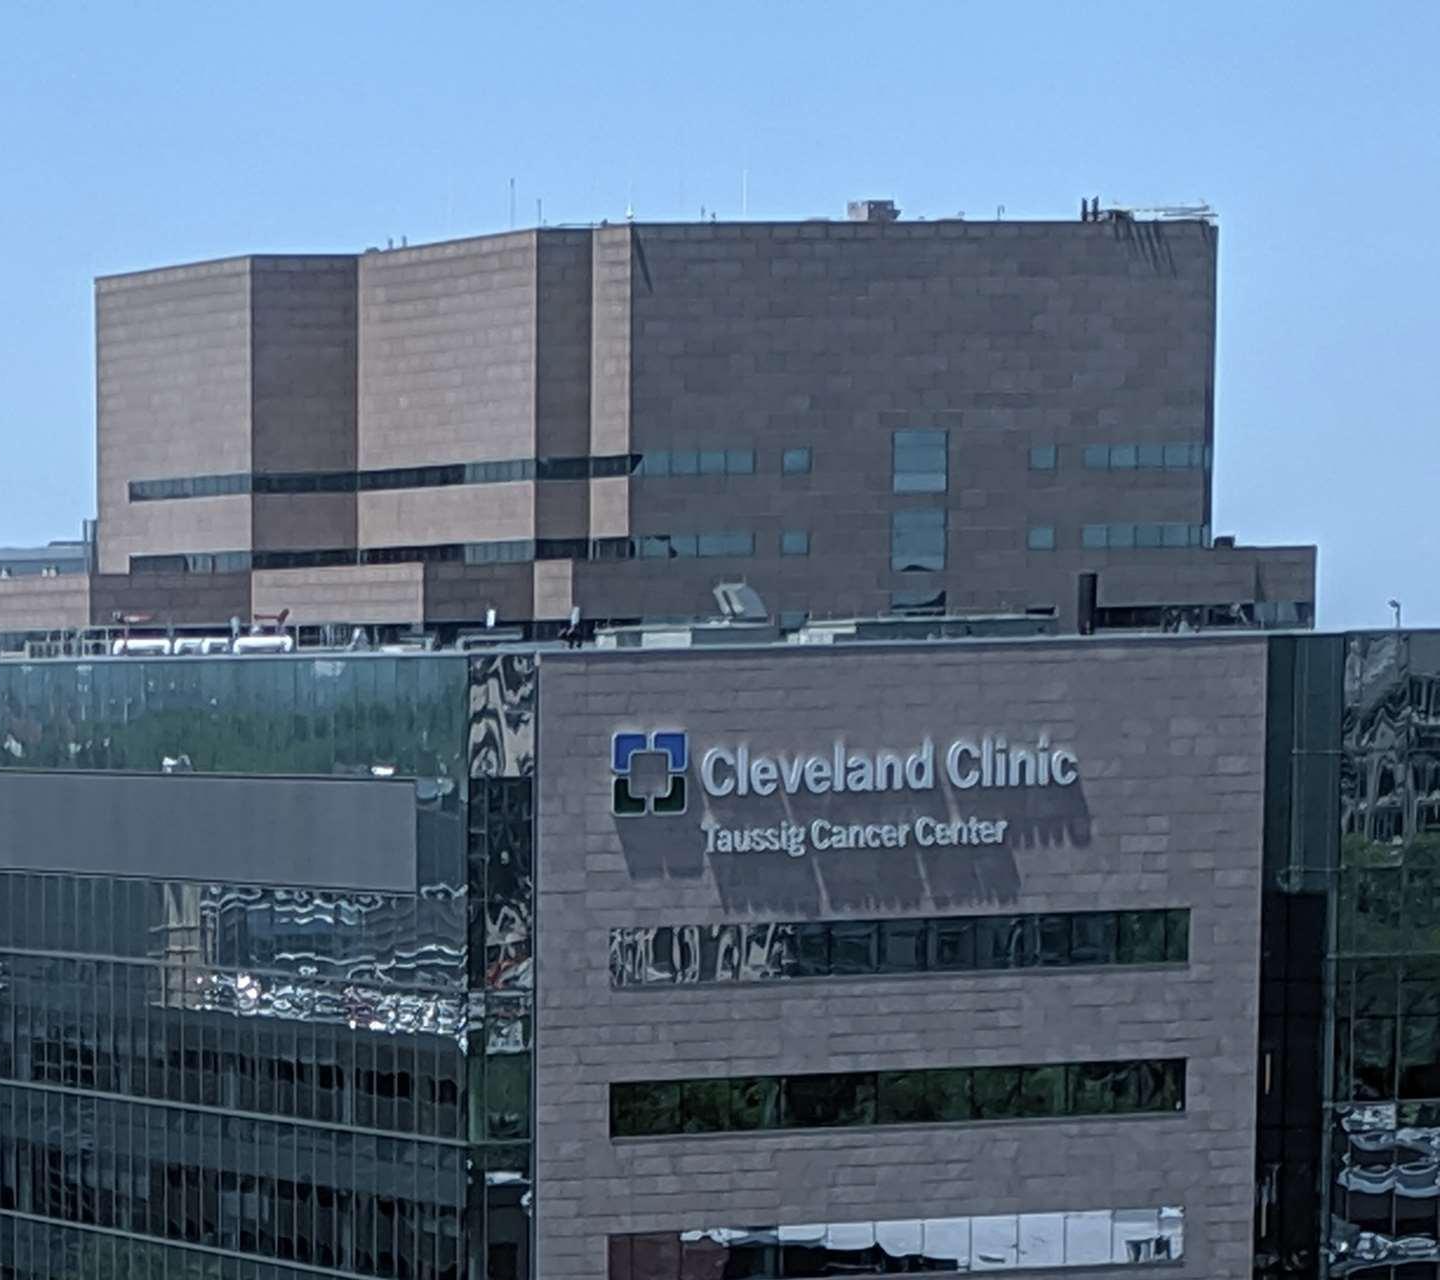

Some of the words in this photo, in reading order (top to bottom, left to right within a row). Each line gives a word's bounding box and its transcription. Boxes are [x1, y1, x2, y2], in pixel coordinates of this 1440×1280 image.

[701, 740, 935, 797] Cleveland
[946, 736, 1079, 789] Clinic
[701, 817, 805, 856] Taussig
[811, 818, 910, 850] Cancer
[915, 815, 1007, 846] Center
